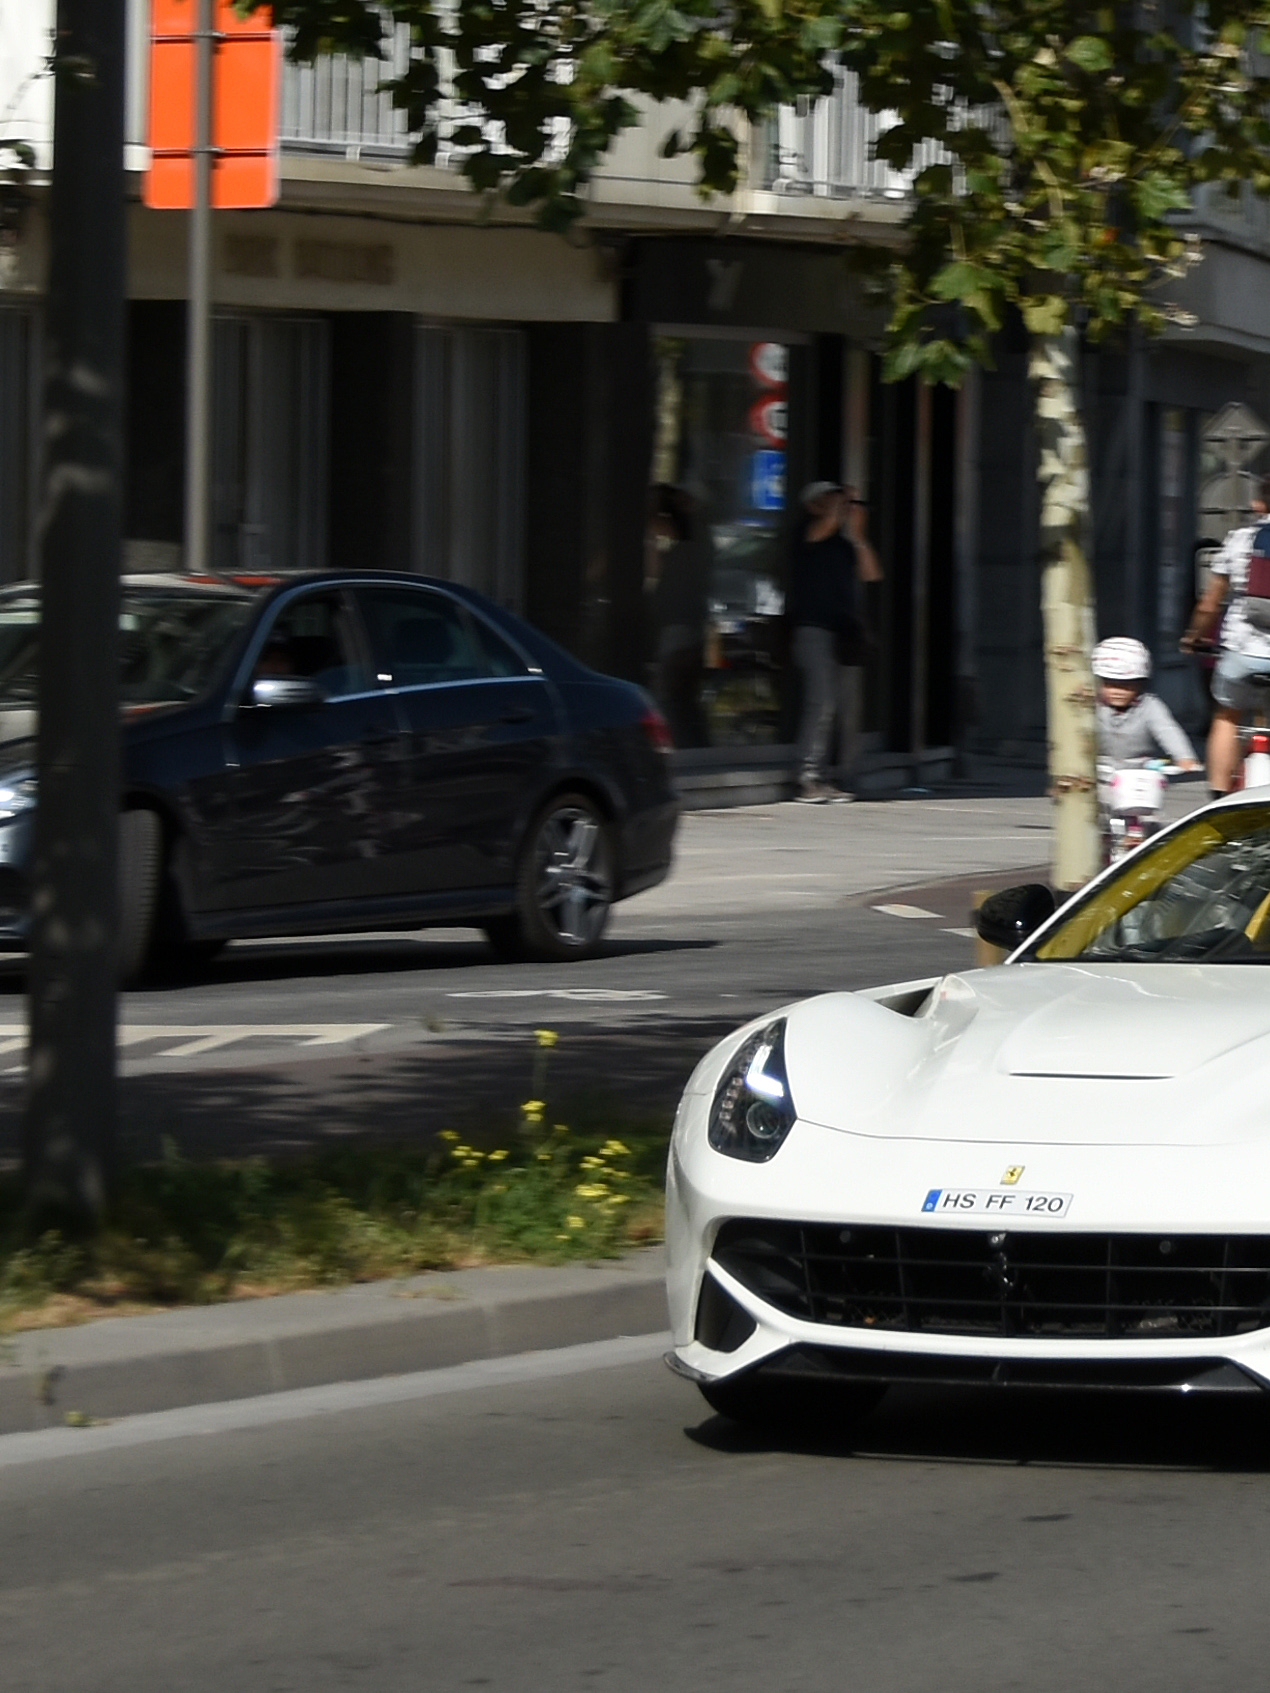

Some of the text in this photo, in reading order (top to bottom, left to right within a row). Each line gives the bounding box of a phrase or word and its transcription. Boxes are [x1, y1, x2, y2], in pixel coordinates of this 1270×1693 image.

[942, 1192, 1064, 1213] HS FF 120
